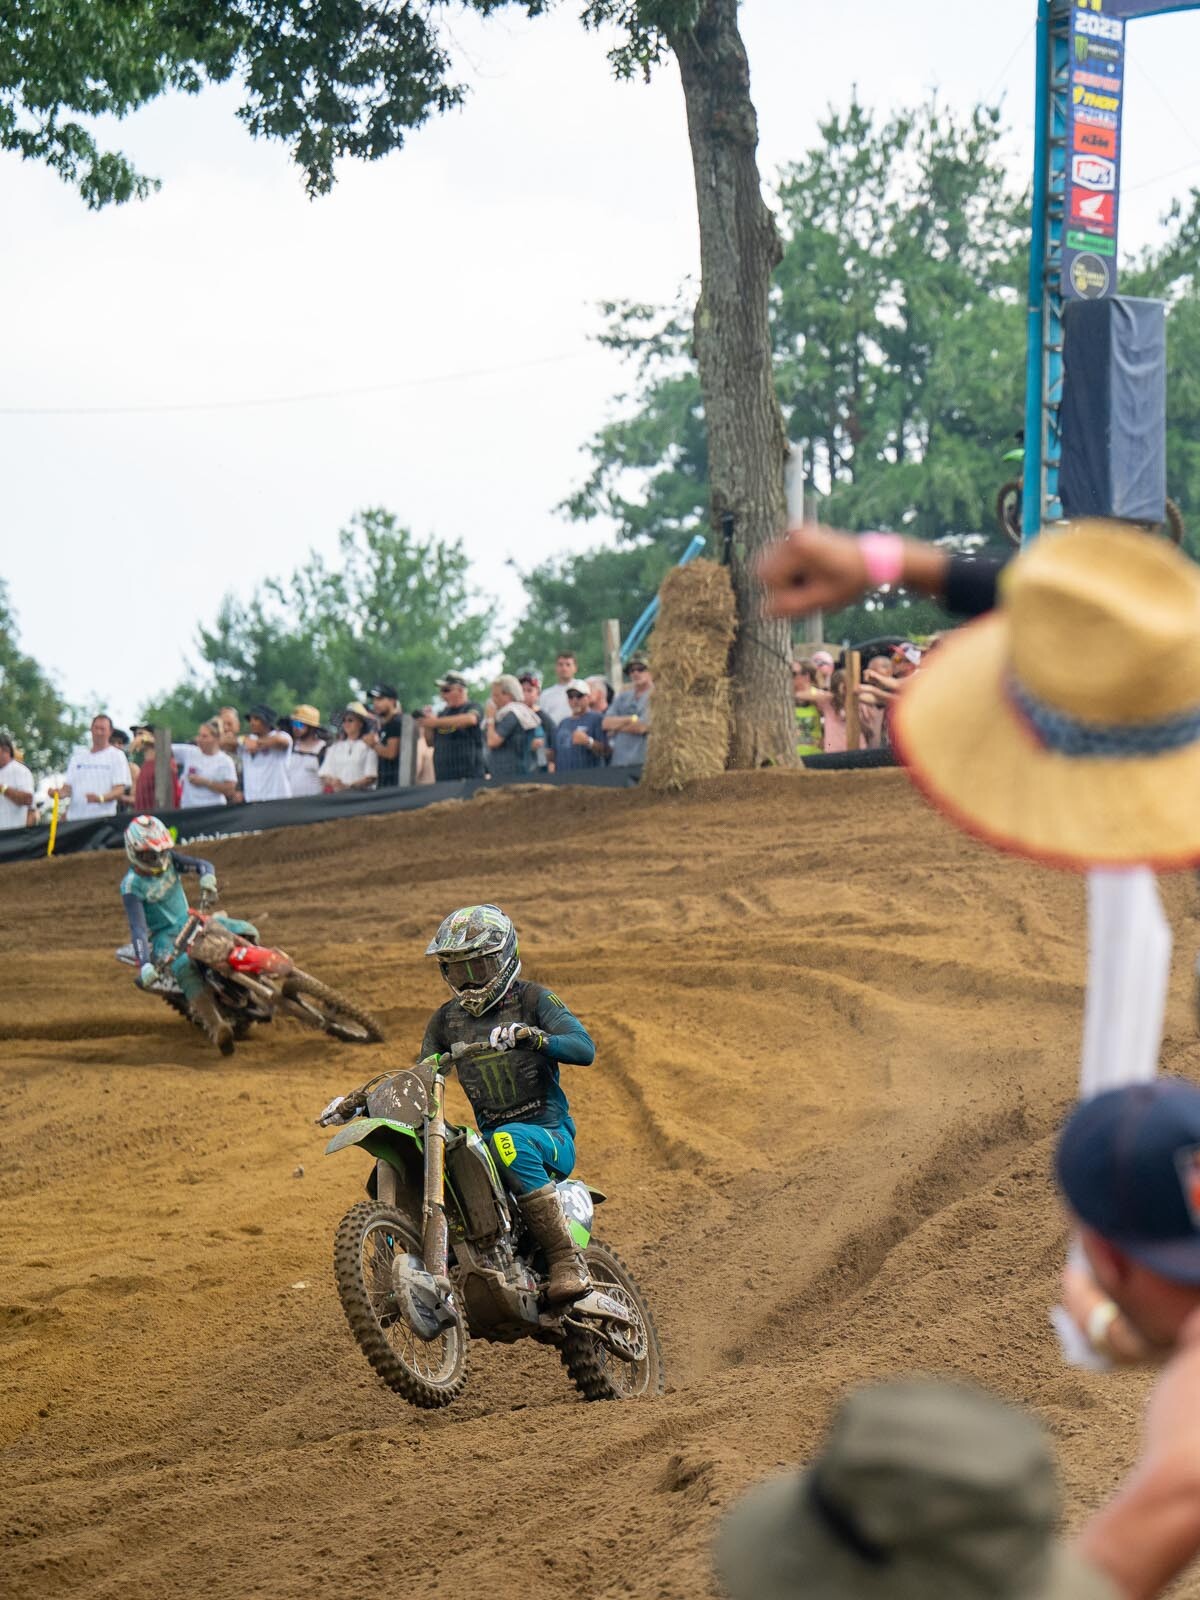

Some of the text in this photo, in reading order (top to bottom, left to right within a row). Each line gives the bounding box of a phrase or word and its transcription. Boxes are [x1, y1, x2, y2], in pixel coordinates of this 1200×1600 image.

[1074, 11, 1123, 42] 2023
[500, 1136, 513, 1157] FOX
[561, 1184, 594, 1221] 30
